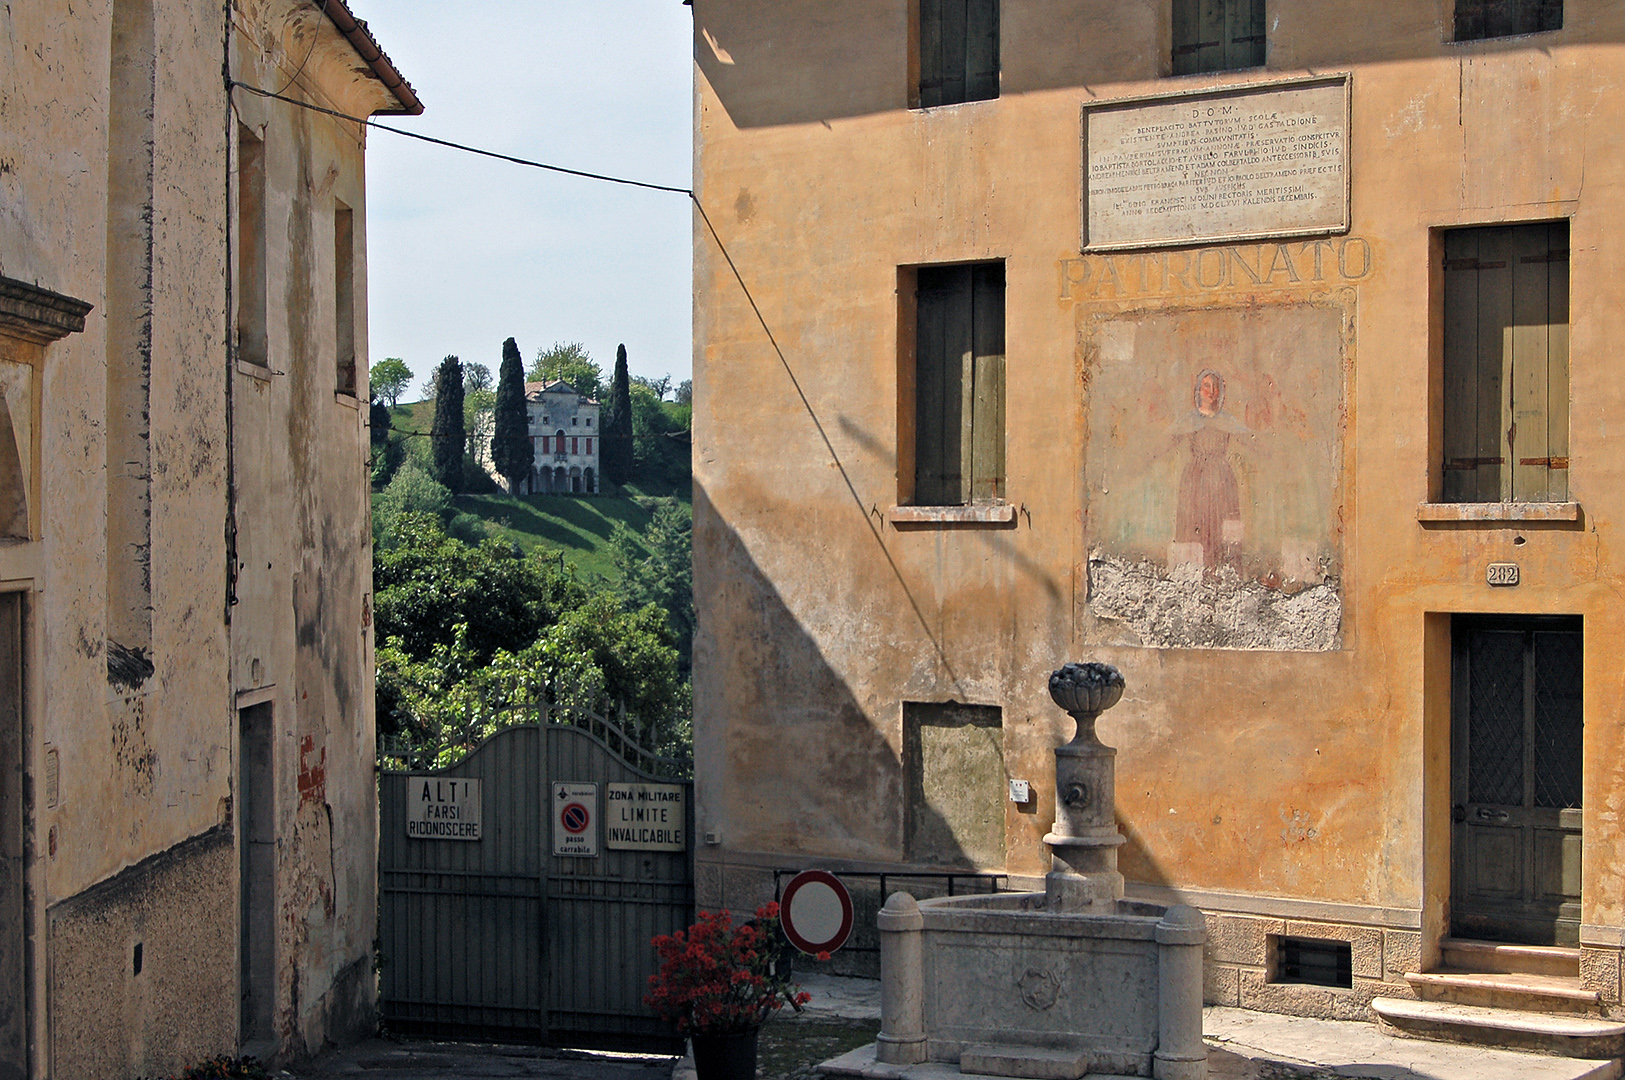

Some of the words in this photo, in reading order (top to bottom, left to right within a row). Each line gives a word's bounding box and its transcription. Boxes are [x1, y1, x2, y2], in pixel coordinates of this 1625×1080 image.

[1059, 238, 1370, 300] PATRONATO
[1489, 567, 1516, 580] 282
[609, 790, 634, 800] ZONA
[638, 792, 680, 802] MILITARE
[428, 805, 460, 820] FARSI
[622, 808, 668, 822] LIMITE
[410, 821, 478, 836] RICONOSCERE
[566, 836, 584, 844] passo
[608, 828, 682, 844] INVALICABILE
[560, 845, 590, 854] carrabile
